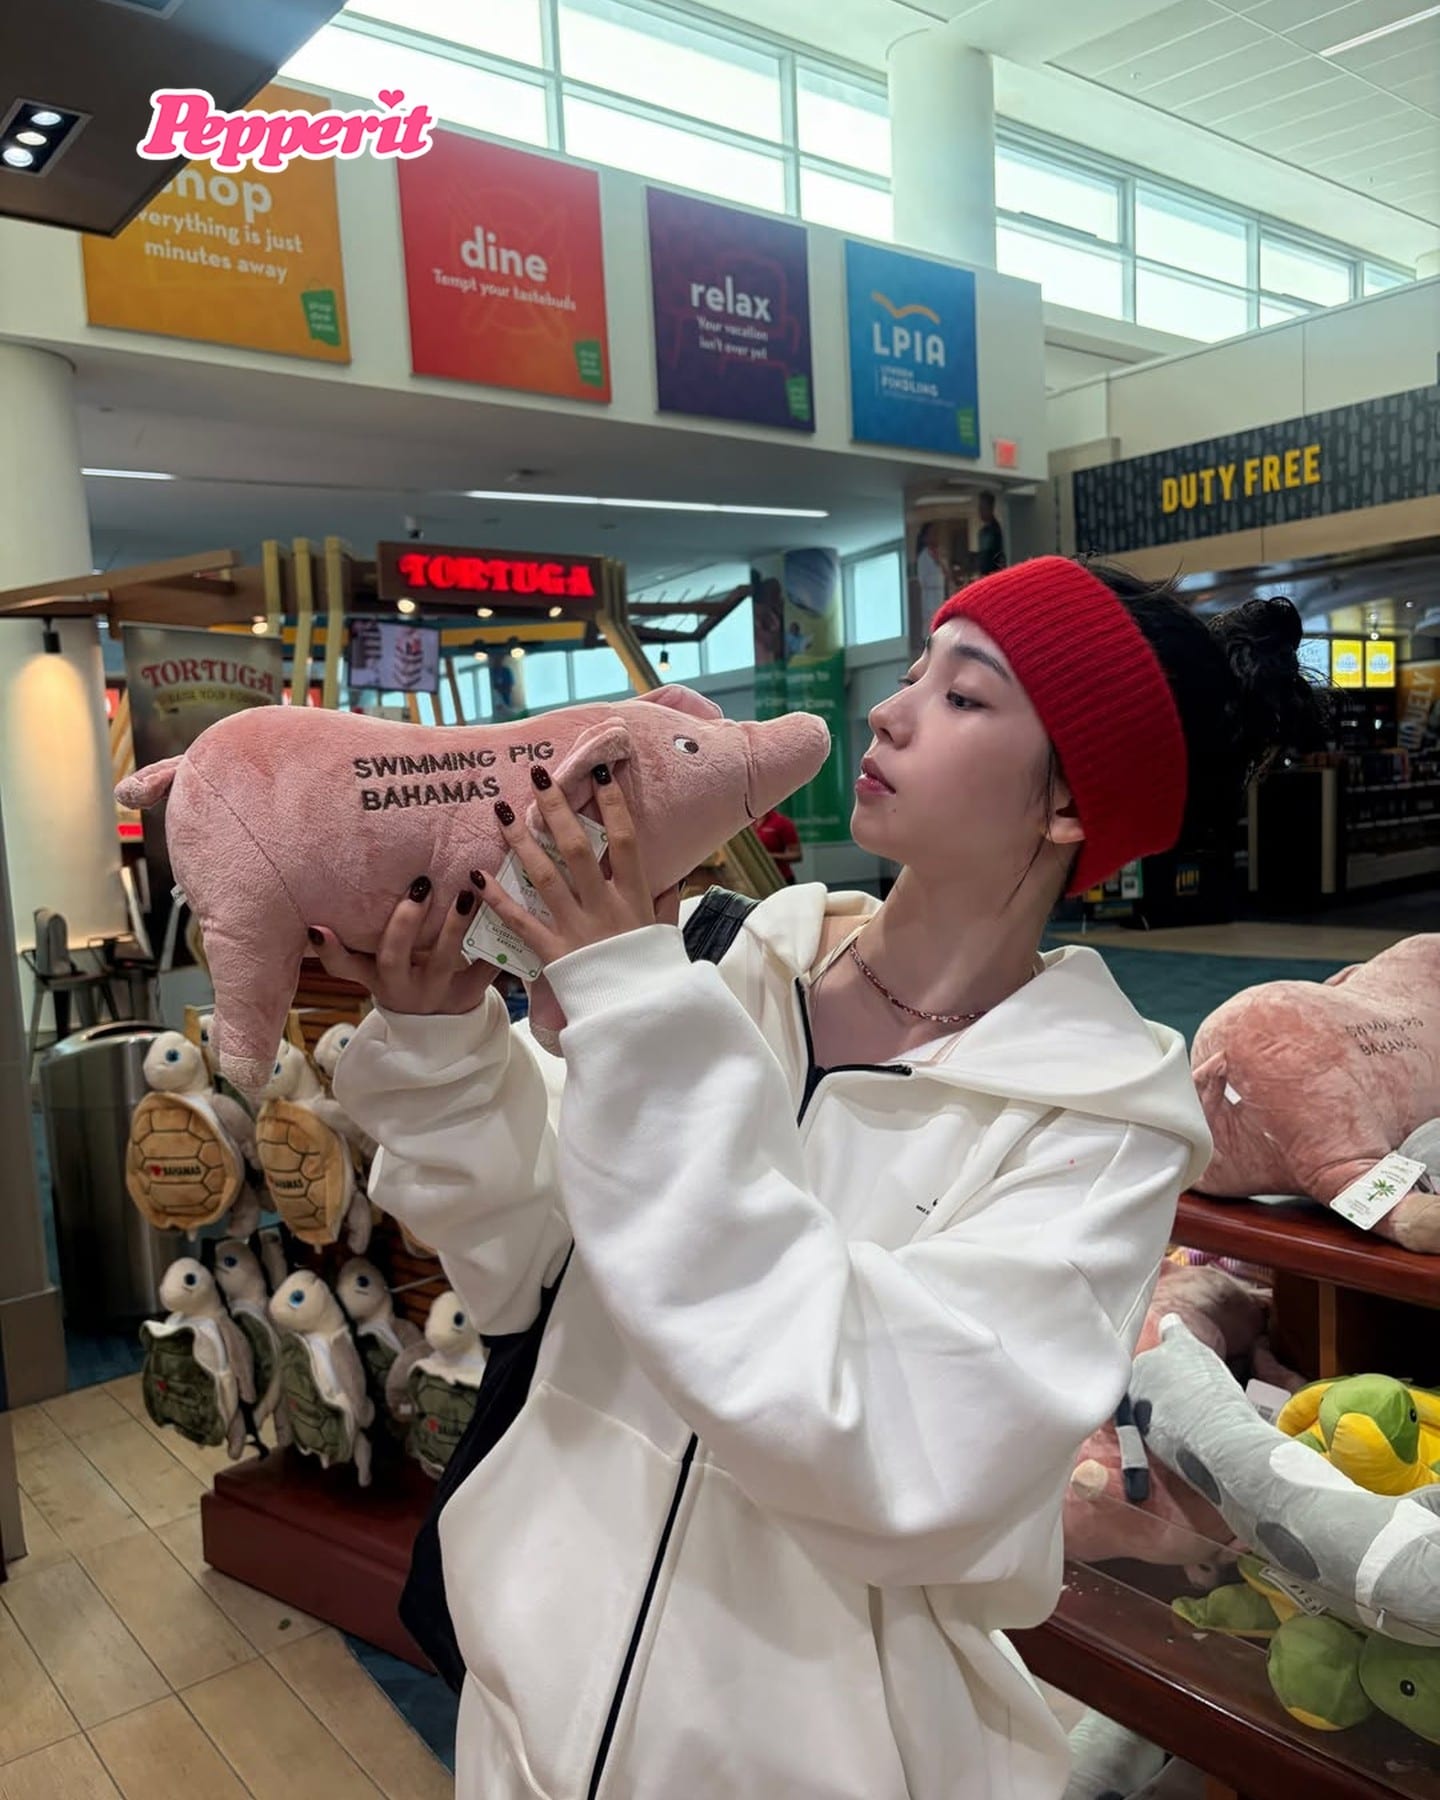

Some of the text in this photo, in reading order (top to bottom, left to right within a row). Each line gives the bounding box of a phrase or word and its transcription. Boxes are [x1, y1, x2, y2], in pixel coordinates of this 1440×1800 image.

[134, 209, 303, 253] verything is just
[144, 240, 288, 284] minutes away
[460, 225, 548, 283] dine
[433, 268, 477, 293] Tempt
[480, 282, 510, 297] your
[690, 275, 772, 323] relax
[696, 315, 722, 332] Your
[873, 321, 945, 368] LPIA
[1161, 444, 1321, 514] DUTY FREE
[400, 553, 595, 597] TORTUGA
[141, 658, 275, 694] TORTUGA
[353, 741, 554, 779] SWIMMING PIG
[361, 776, 500, 811] BAHAMAS
